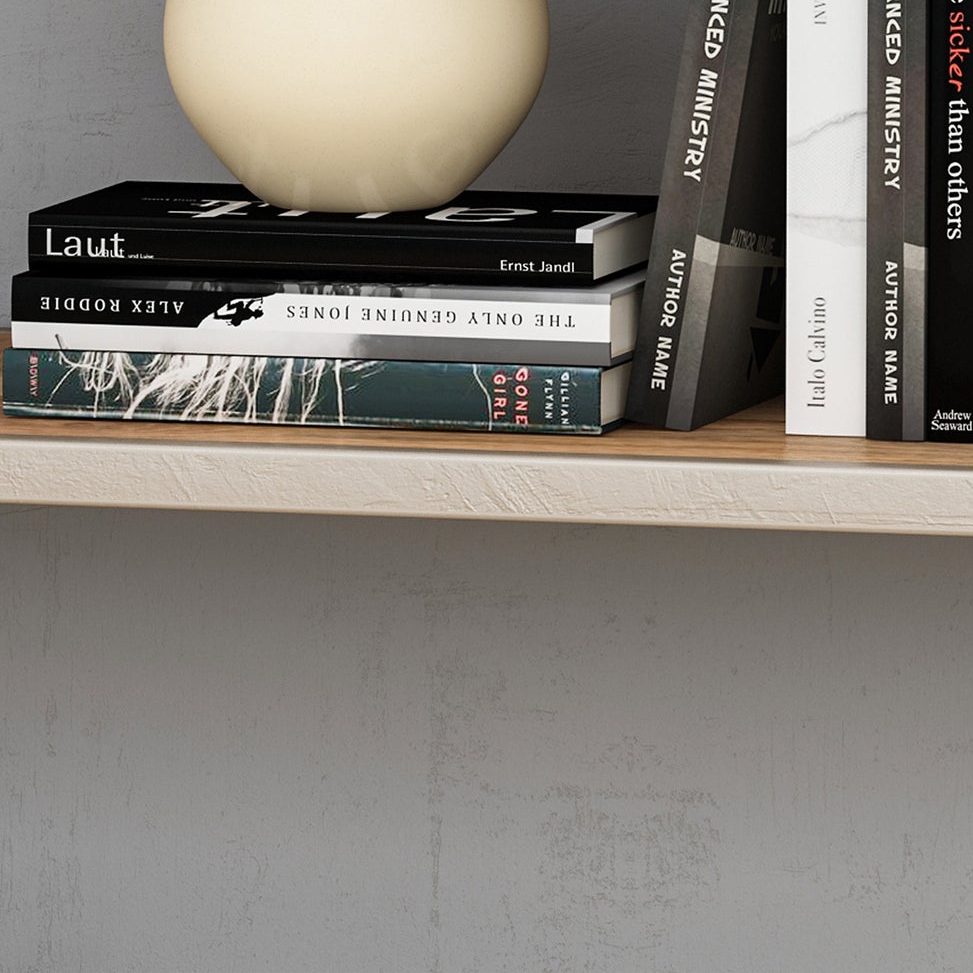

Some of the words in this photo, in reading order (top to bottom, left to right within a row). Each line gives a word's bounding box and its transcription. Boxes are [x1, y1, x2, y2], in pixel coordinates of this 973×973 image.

[948, 11, 971, 93] sicker
[683, 68, 719, 183] MINISTRY
[884, 75, 902, 190] MINISTRY
[948, 99, 970, 154] than
[946, 161, 968, 240] others
[46, 228, 125, 258] Laut
[500, 259, 534, 272] Ernst
[538, 260, 575, 273] Jandl
[40, 296, 120, 312] RODDIE
[132, 300, 184, 314] ALEX
[660, 248, 687, 328] AUTHOR
[884, 260, 898, 340] AUTHOR
[287, 305, 349, 320] JONES
[361, 307, 457, 323] GENUINE
[468, 311, 523, 326] ONLY
[535, 314, 576, 327] THE
[807, 297, 827, 363] Calvino
[651, 337, 672, 390] NAME
[884, 350, 898, 405] NAME
[493, 373, 506, 419] GIRL
[515, 367, 529, 425] GONE
[544, 378, 553, 419] FLYNN
[560, 371, 570, 425] GILLIAN
[807, 369, 826, 409] Italo
[931, 420, 973, 432] Seaward
[933, 409, 972, 421] Andrew
